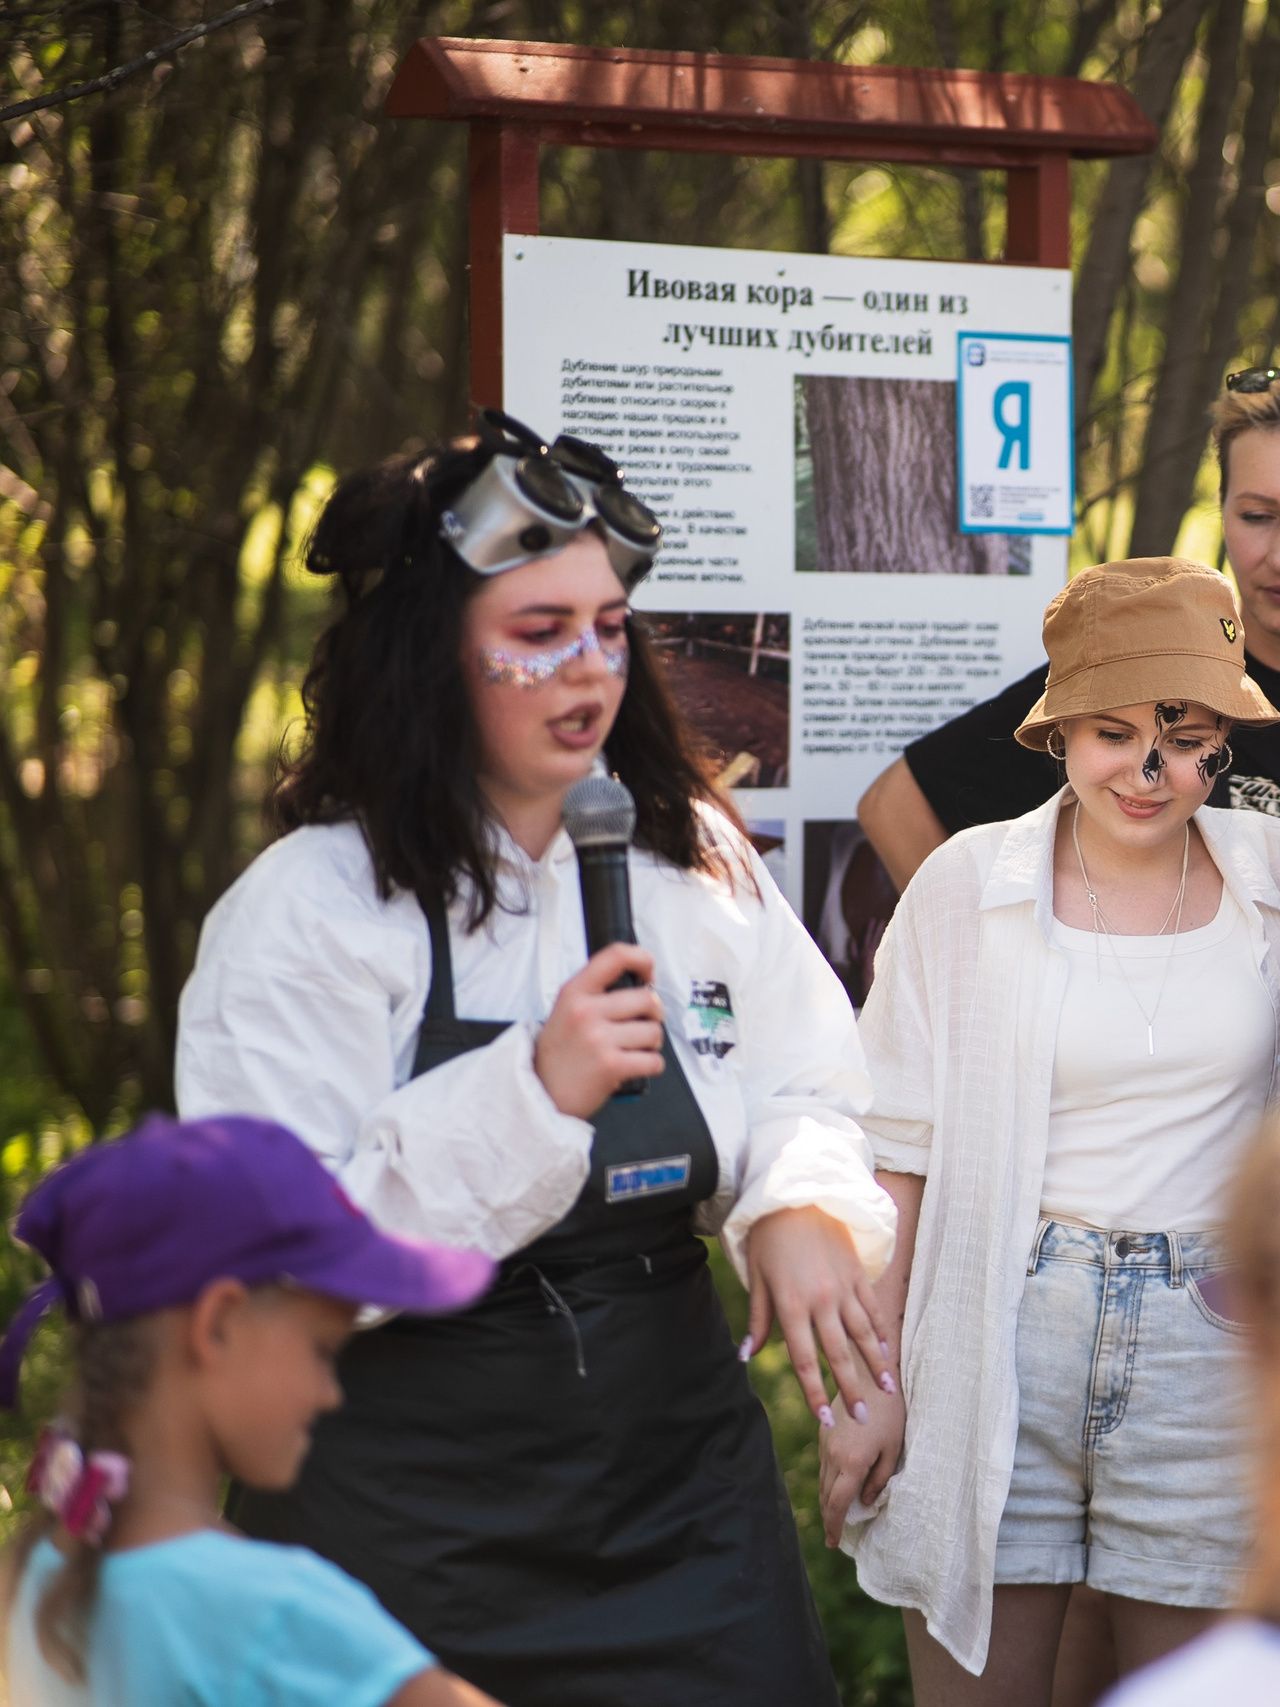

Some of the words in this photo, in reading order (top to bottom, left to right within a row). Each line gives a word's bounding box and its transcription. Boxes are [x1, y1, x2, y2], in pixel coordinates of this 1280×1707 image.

[627, 269, 737, 302] Ивовая
[747, 283, 814, 313] кора
[863, 290, 929, 314] один
[939, 294, 968, 315] из
[663, 322, 778, 351] лучших
[788, 325, 933, 358] дубителей
[622, 364, 649, 376] шкур
[635, 381, 654, 389] или
[993, 381, 1031, 470] Я
